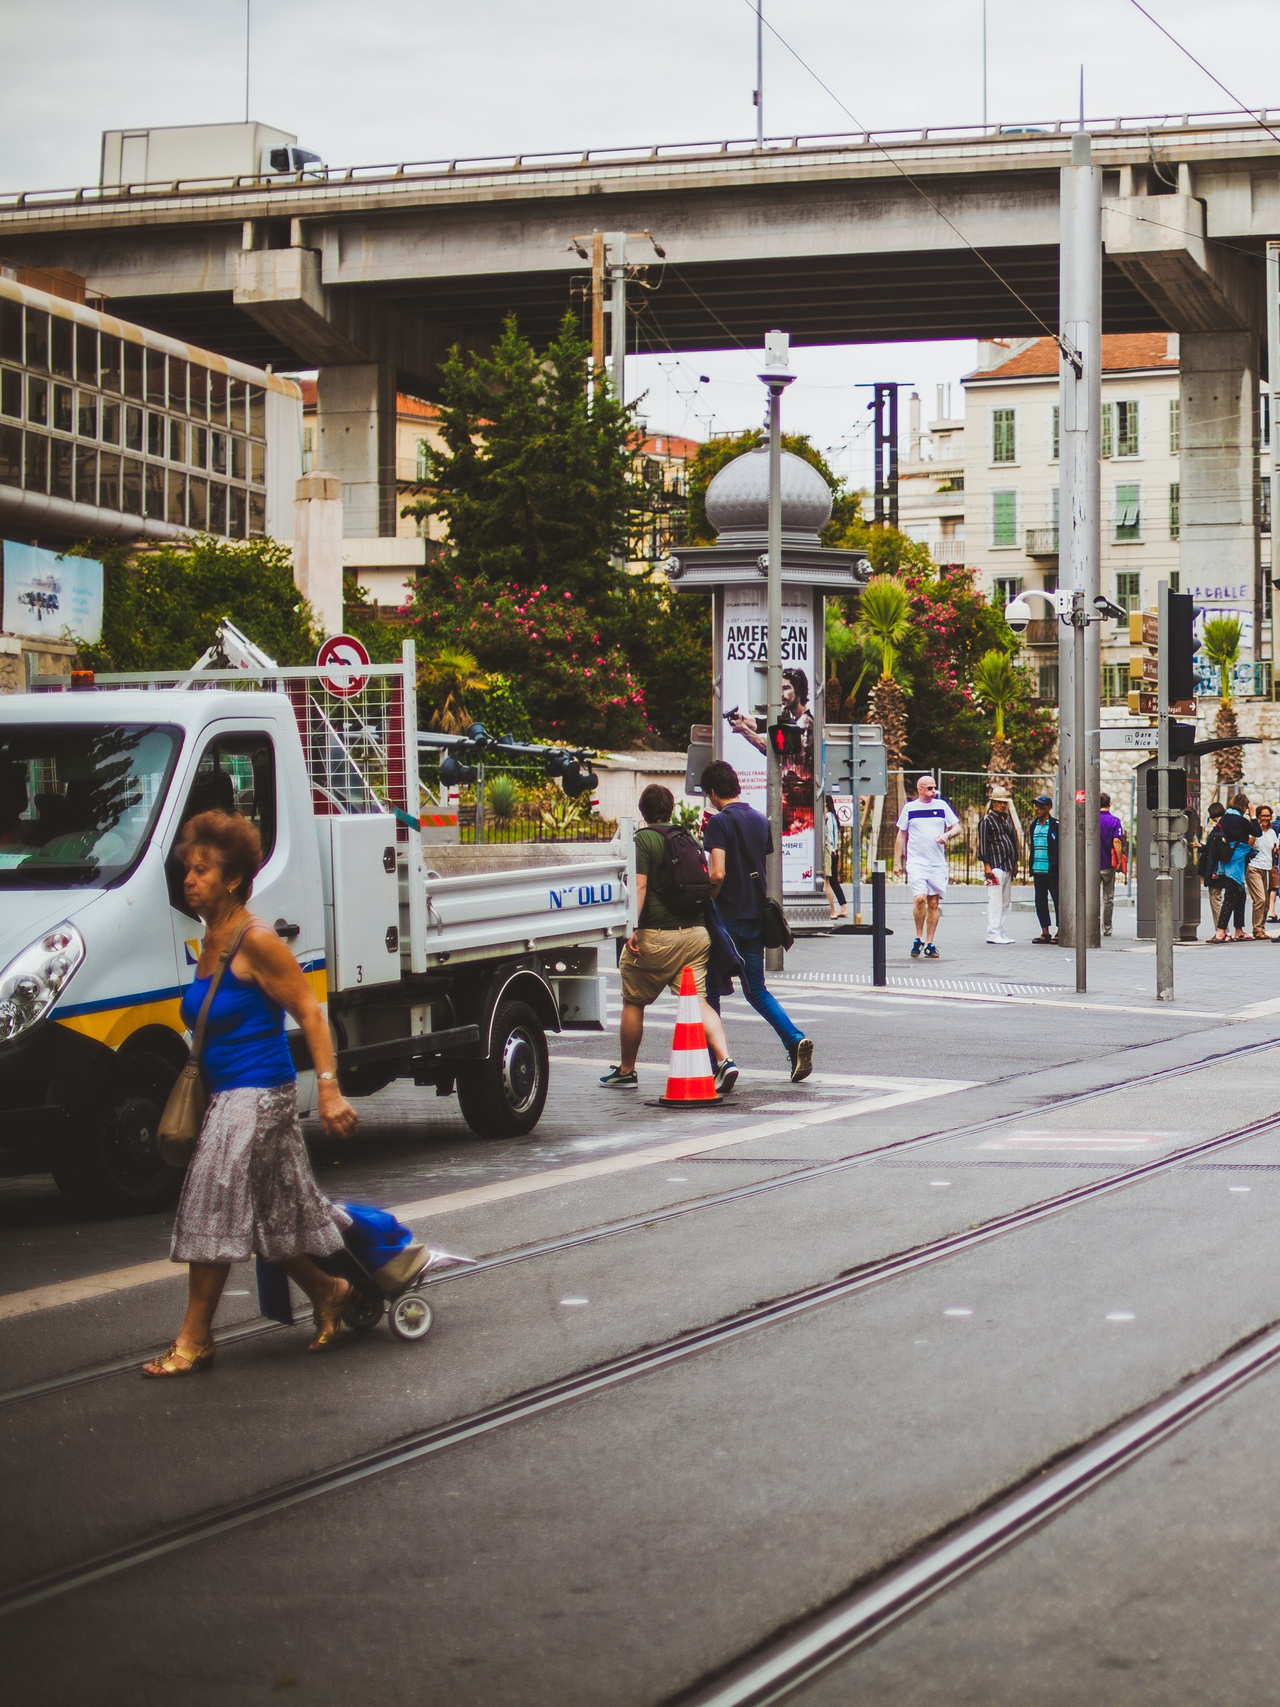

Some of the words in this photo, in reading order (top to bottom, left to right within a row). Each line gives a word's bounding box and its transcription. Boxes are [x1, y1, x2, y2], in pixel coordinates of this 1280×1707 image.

[727, 625, 808, 642] AMERCAN
[727, 642, 807, 661] ASSASIN
[356, 964, 363, 984] 3
